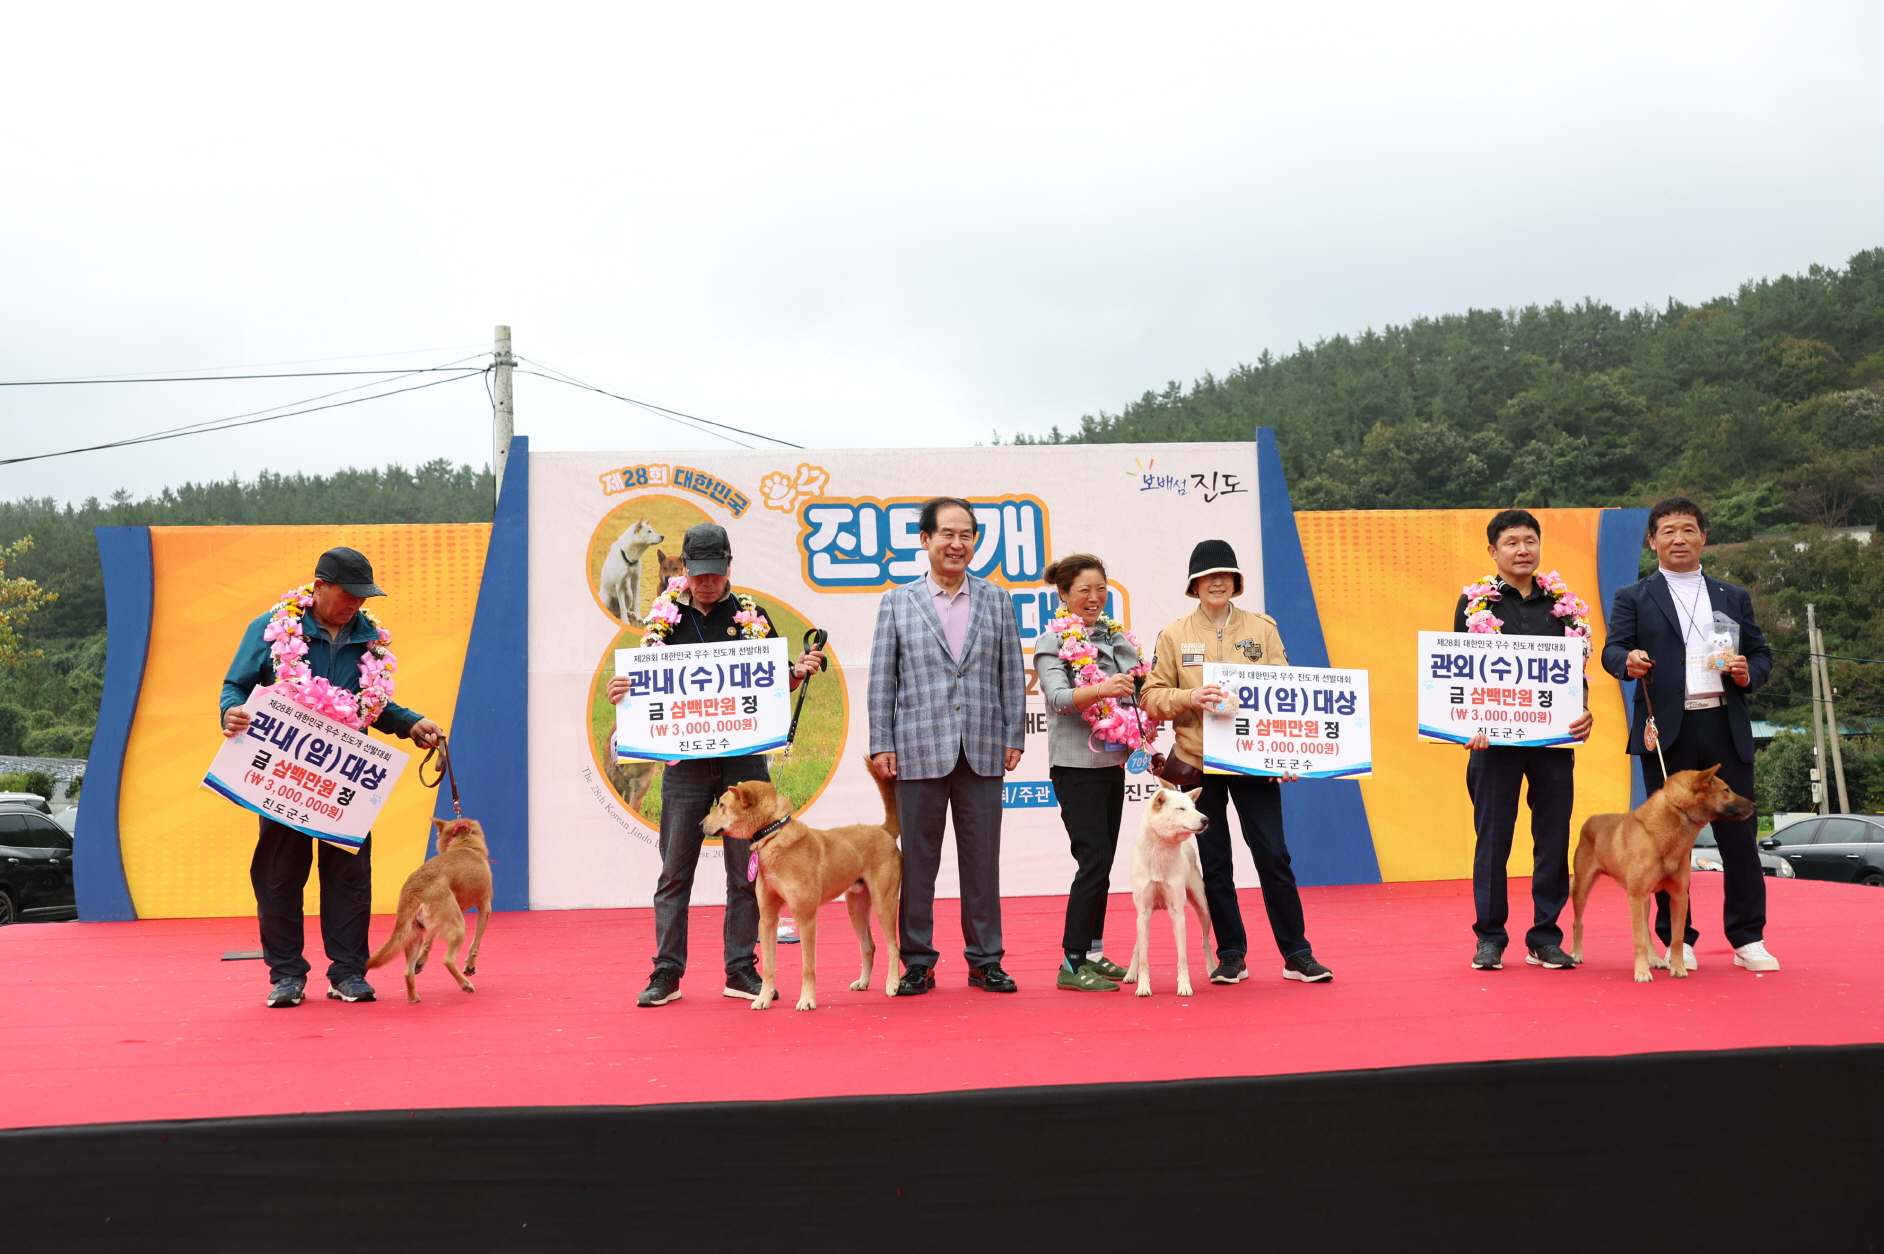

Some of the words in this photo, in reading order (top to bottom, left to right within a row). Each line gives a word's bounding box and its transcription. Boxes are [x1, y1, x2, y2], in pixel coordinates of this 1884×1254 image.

[602, 466, 668, 492] 제28회
[674, 469, 749, 516] 대한민국
[1140, 474, 1187, 496] 보배섬
[1190, 471, 1248, 503] 진도
[634, 653, 658, 663] 제28회
[661, 650, 691, 661] 대한민국
[694, 649, 709, 660] 우수
[713, 647, 736, 658] 진도개
[739, 645, 769, 656] 선발대회
[1436, 638, 1460, 647] 제28회
[1463, 640, 1492, 649] 대한민국
[1495, 640, 1510, 650] 우수
[1513, 642, 1534, 651] 진도개
[1537, 643, 1566, 652] 선발대회
[628, 661, 776, 696] 관내(수)대상
[1248, 671, 1277, 681] 대한민국
[1280, 672, 1294, 682] 우수
[1297, 673, 1320, 683] 진도개
[1322, 674, 1351, 684] 선발대회
[1431, 654, 1571, 684] 관외(수)대상
[649, 702, 664, 720] 금
[670, 696, 736, 719] 삼백만원
[742, 695, 758, 714] 정
[1238, 686, 1357, 716] 외(암)대상
[1450, 687, 1464, 704] 금
[1470, 687, 1532, 707] 삼백만원
[1538, 690, 1553, 708] 정
[268, 699, 293, 716] 제28회
[294, 711, 324, 729] 대한민국
[325, 725, 339, 737] 우수
[341, 733, 362, 748] 진도개
[364, 744, 392, 762] 선발대회
[1235, 718, 1250, 735] 금
[1256, 719, 1319, 738] 삼백만원
[1324, 721, 1340, 739] 정
[247, 711, 387, 790] 관내(암)대상
[679, 738, 730, 752] 진도군수
[252, 750, 272, 770] 금
[272, 760, 337, 798] 삼백만원
[337, 787, 356, 806] 정
[1264, 758, 1313, 770] 진도군수
[263, 798, 310, 824] 진도군수
[582, 766, 592, 783] The
[591, 785, 606, 805] 28th
[604, 803, 630, 829] Korean
[628, 826, 652, 844] Jindo
